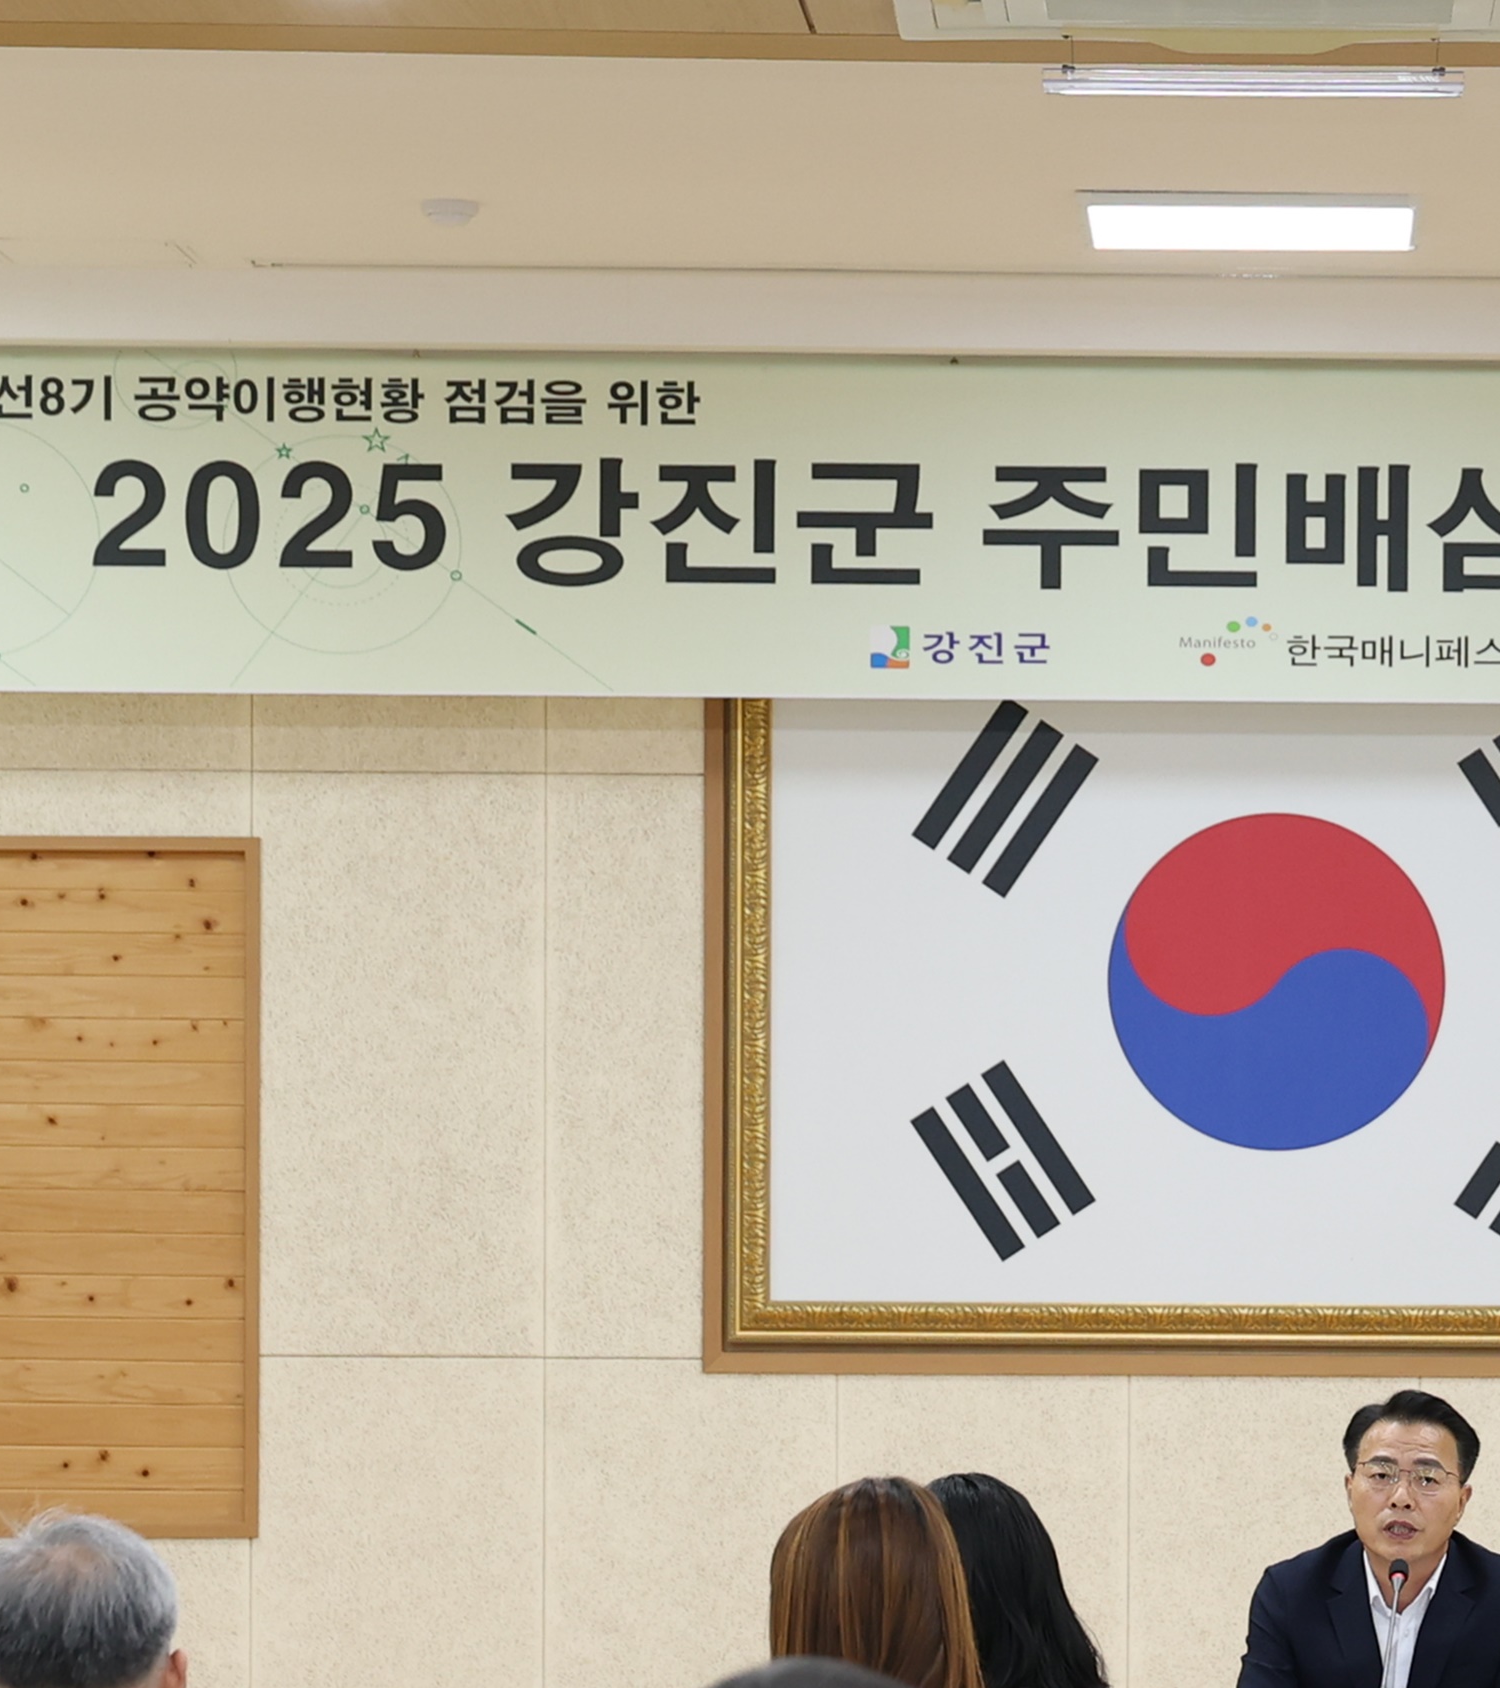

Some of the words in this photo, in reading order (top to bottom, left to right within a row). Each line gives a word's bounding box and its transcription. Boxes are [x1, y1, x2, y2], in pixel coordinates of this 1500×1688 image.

[133, 376, 425, 425] 공약이행현황
[444, 378, 587, 426] 점검을
[607, 380, 701, 427] 위한
[91, 459, 447, 570] 2025
[504, 457, 934, 587] 강진군
[922, 631, 1050, 664] 강진군
[1179, 636, 1256, 649] Manifesto
